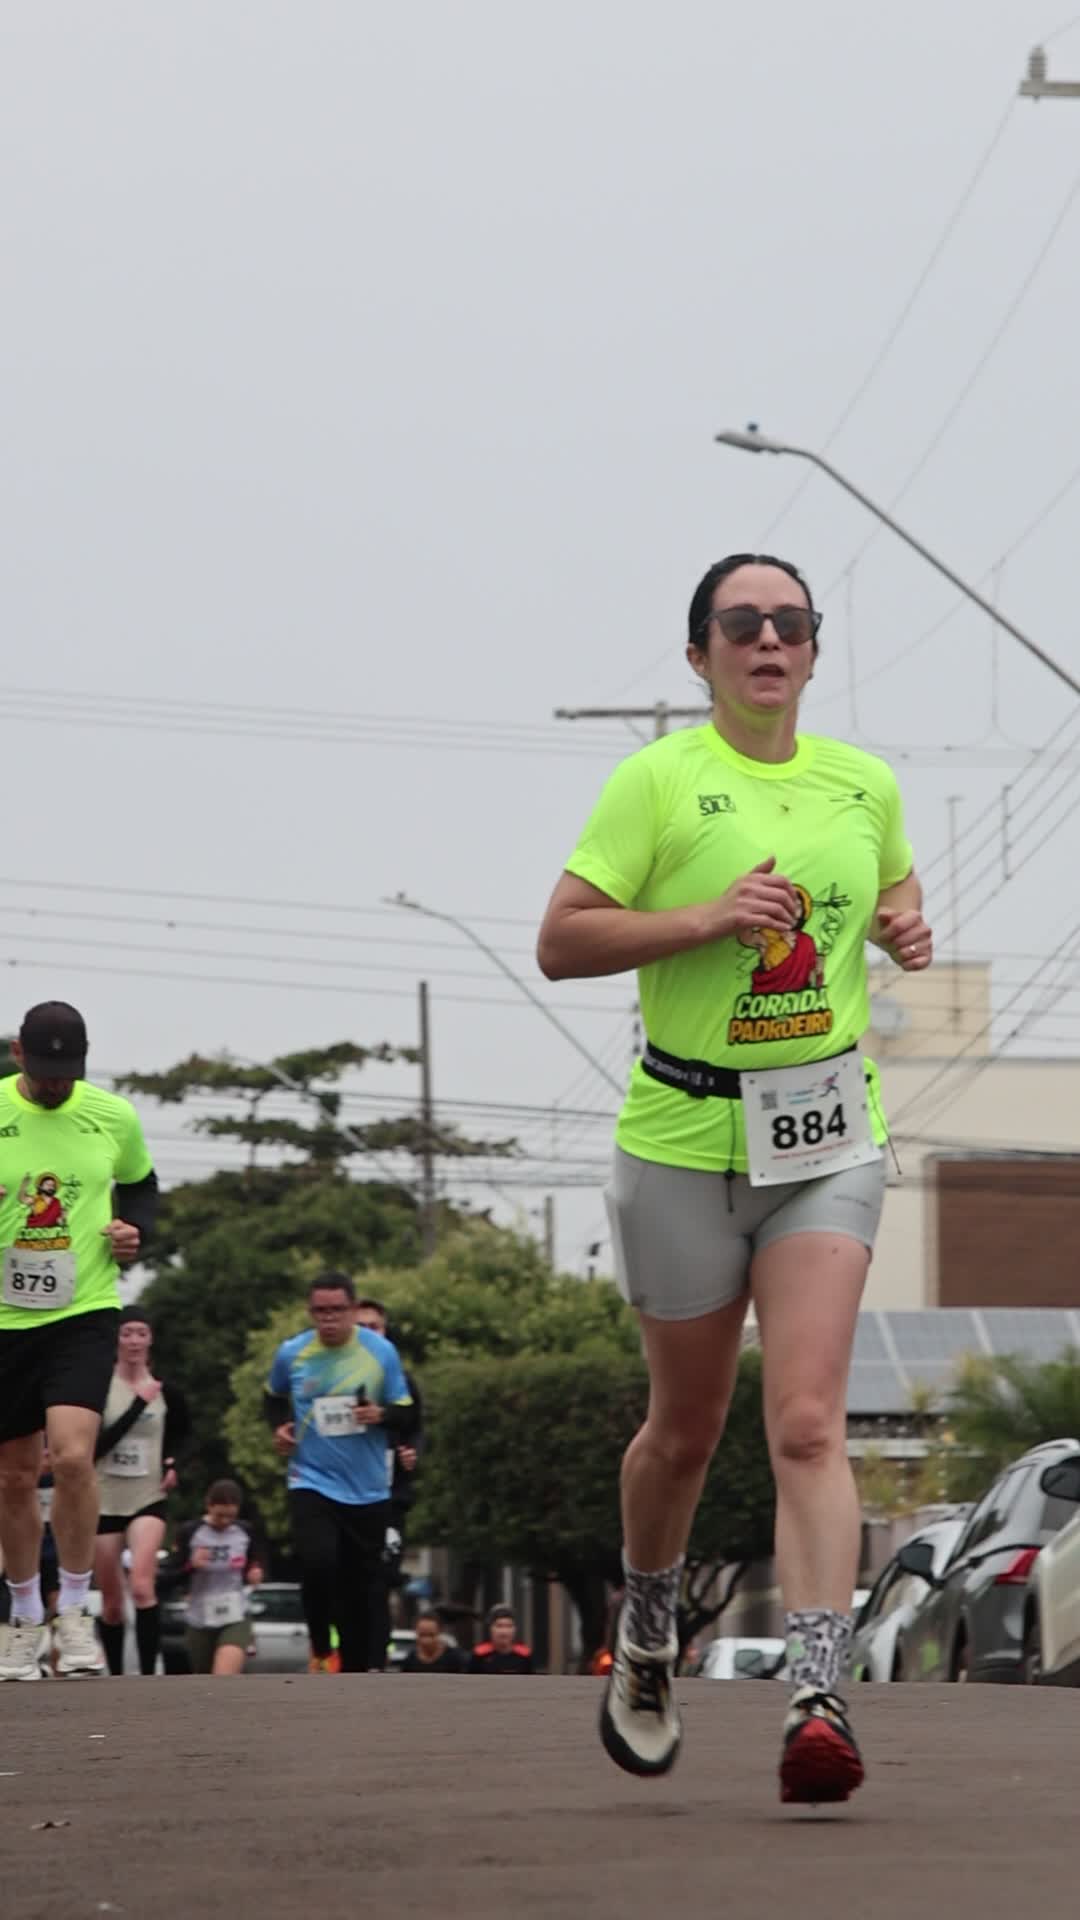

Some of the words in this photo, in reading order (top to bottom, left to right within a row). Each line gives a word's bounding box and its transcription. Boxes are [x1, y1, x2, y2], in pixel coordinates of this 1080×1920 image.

[735, 987, 828, 1020] CORRIDA
[729, 1009, 832, 1043] PADROEIRO
[771, 1103, 847, 1150] 884
[12, 1272, 57, 1293] 879
